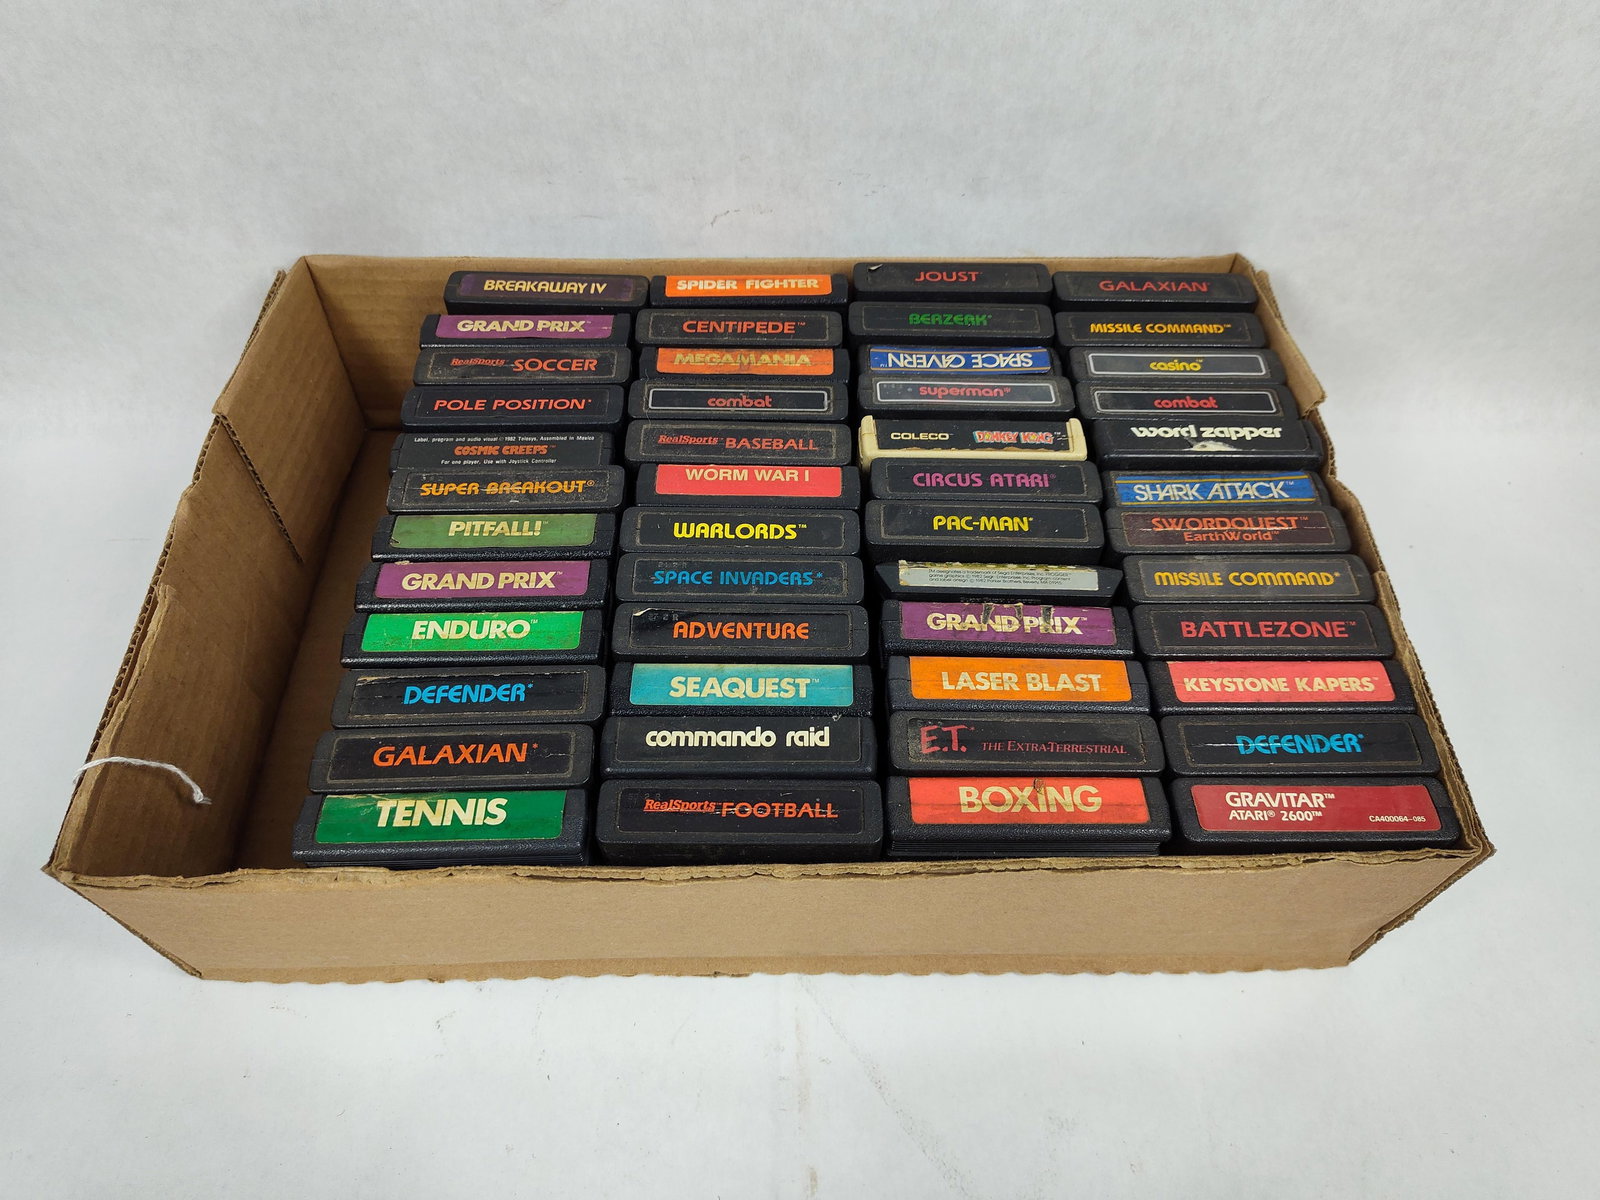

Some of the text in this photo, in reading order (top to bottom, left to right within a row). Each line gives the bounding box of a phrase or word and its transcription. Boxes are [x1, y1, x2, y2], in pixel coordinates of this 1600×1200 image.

[483, 279, 608, 294] BREAKAWAY IV
[676, 279, 738, 291] SPIDER
[456, 319, 535, 333] GRAND
[1090, 323, 1142, 334] MISSILE
[512, 358, 598, 372] SOCCER
[673, 352, 813, 367] MEGAMANIA
[971, 353, 1034, 369] SPACE
[433, 399, 487, 411] POLE
[707, 393, 772, 408] combat
[1154, 395, 1219, 409] combat
[890, 432, 950, 441] COLECO
[973, 430, 1018, 444] DONKEY
[1130, 424, 1282, 440] word zapper
[453, 445, 500, 456] COSMIC
[725, 438, 819, 450] BASEBALL
[685, 468, 810, 482] WORM WAR I
[912, 472, 984, 487] CIRCUS
[420, 482, 480, 496] SUPER
[1133, 483, 1206, 502] SHARK
[401, 572, 495, 590] GRAND
[653, 570, 713, 585] SPACE
[1154, 571, 1223, 586] MISSILE
[926, 612, 1023, 632] GRAND
[672, 621, 810, 640] ADVENTURE
[941, 671, 1021, 691] LASER
[1183, 677, 1290, 692] KEYSTONE
[645, 726, 830, 748] commando raid
[982, 742, 1004, 751] THE
[1007, 740, 1128, 754] EXTRA-TERRESTRIAL
[958, 785, 1103, 813] BOXING
[376, 797, 509, 828] TENNIS
[721, 802, 839, 819] FOOTBALL
